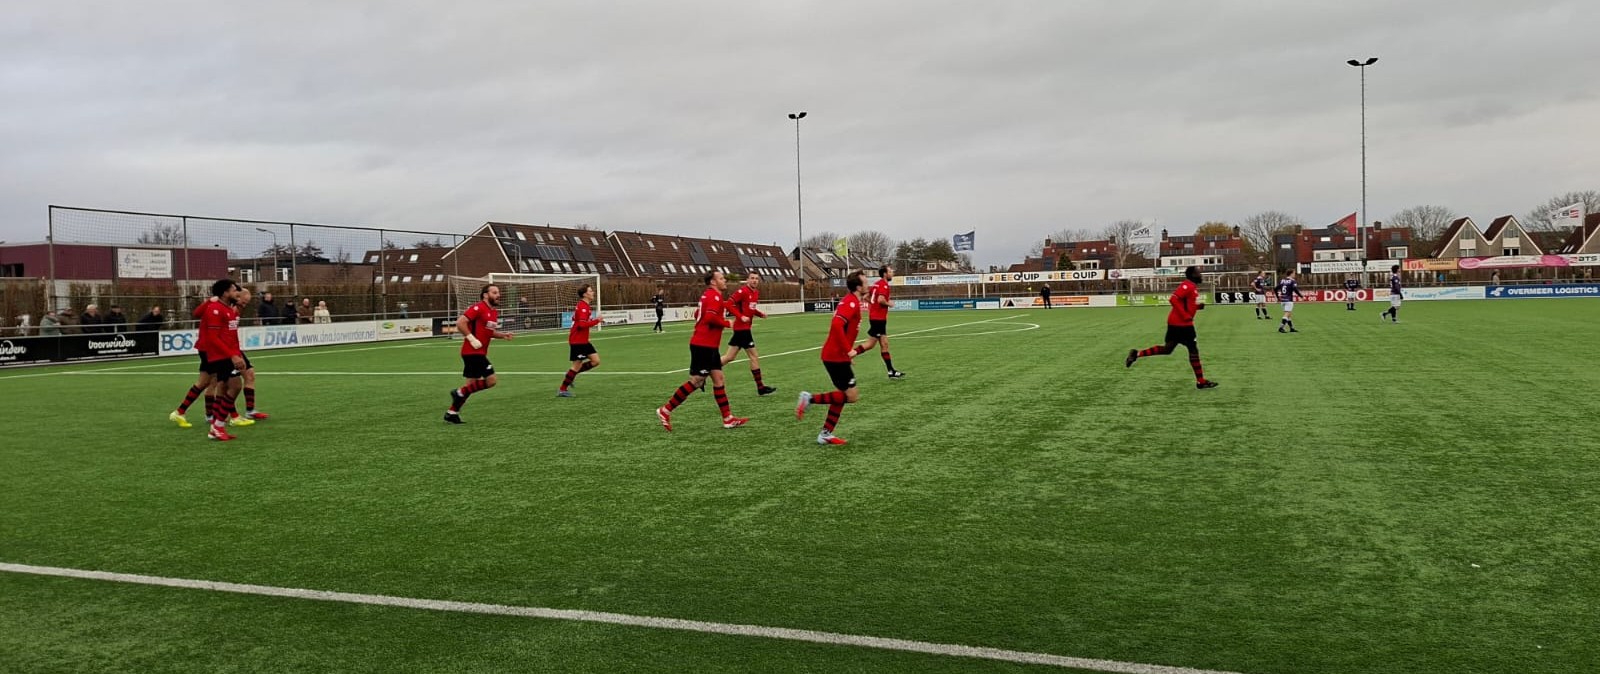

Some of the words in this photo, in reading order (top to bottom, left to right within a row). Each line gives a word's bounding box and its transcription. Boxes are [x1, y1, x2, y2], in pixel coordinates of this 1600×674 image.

[995, 273, 1040, 281] BEEQUIP
[1053, 271, 1098, 279] BEEQUIP
[1324, 290, 1367, 301] DOO
[1507, 287, 1554, 295] OVERMEER
[1554, 286, 1599, 294] LOGISTICS
[161, 333, 193, 351] BOS
[263, 330, 299, 346] DNA
